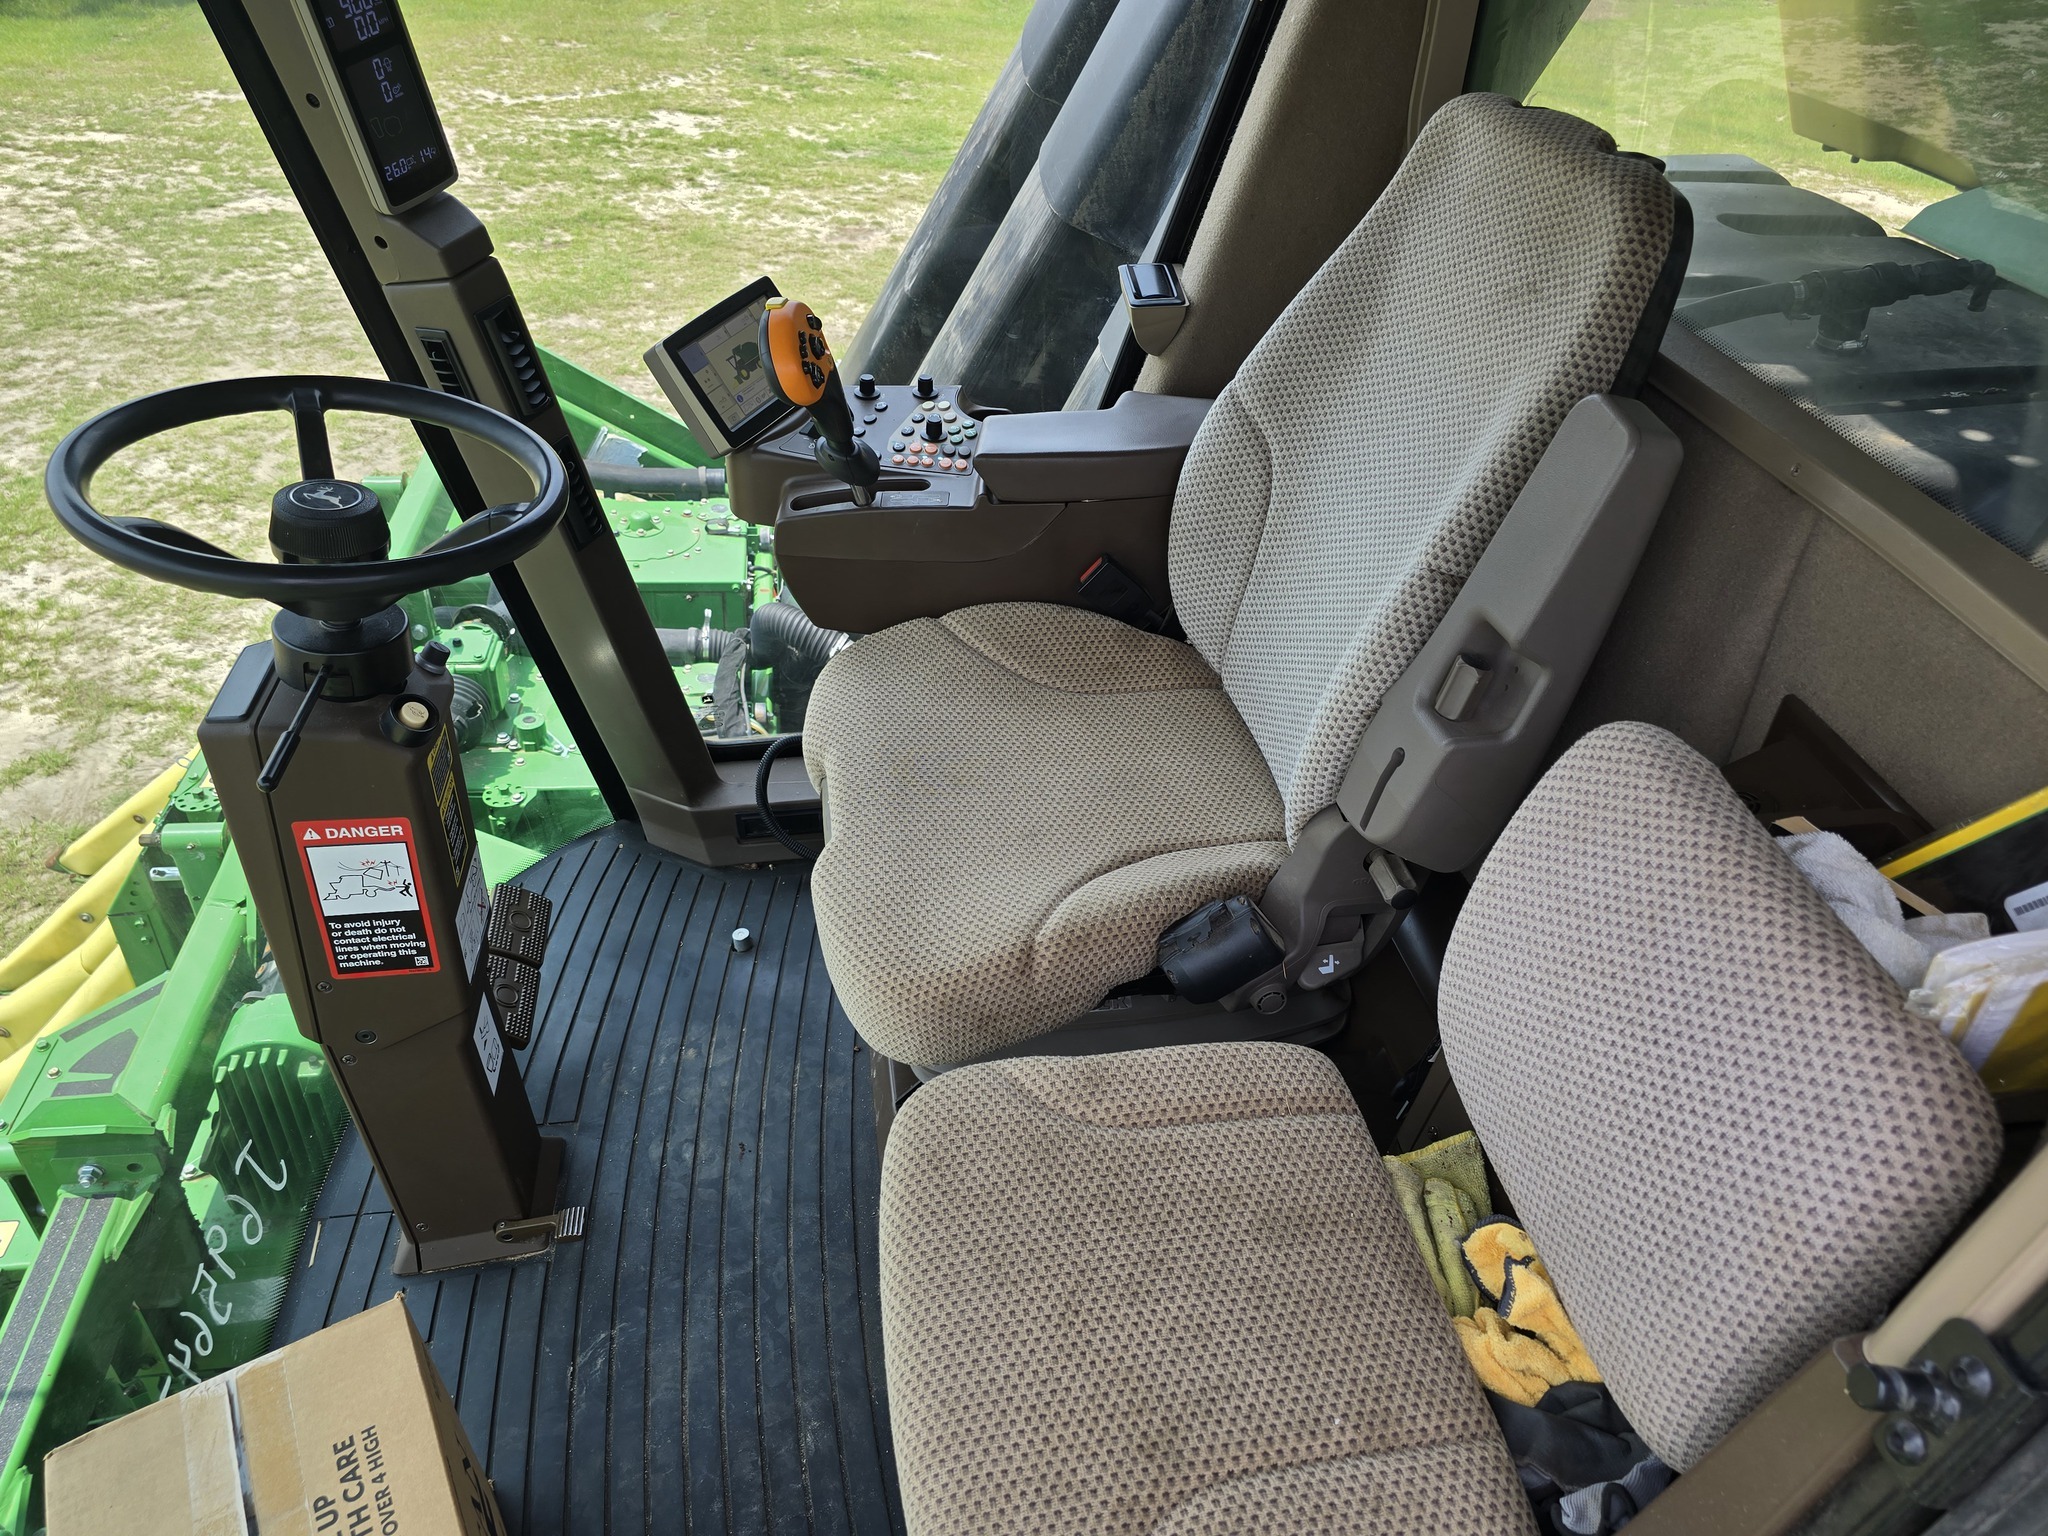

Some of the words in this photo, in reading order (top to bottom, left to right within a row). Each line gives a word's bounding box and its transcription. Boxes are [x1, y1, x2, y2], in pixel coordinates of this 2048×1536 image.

[354, 11, 380, 41] 0.0
[325, 825, 404, 839] DANGER
[343, 920, 371, 929] avoid
[372, 919, 401, 927] injury
[344, 928, 372, 936] death
[374, 926, 387, 934] do
[389, 925, 406, 933] not
[333, 936, 371, 945] contact
[372, 933, 416, 942] electrical
[335, 945, 359, 953] lines
[361, 943, 388, 951] when
[390, 940, 426, 949] moving
[350, 950, 397, 960] operating
[398, 948, 417, 956] this
[339, 959, 384, 968] machine.
[361, 1424, 384, 1472] HIGH
[332, 1435, 365, 1503] CARE
[371, 1471, 387, 1484] 4
[313, 1495, 339, 1532] UP
[374, 1484, 398, 1536] OVER
